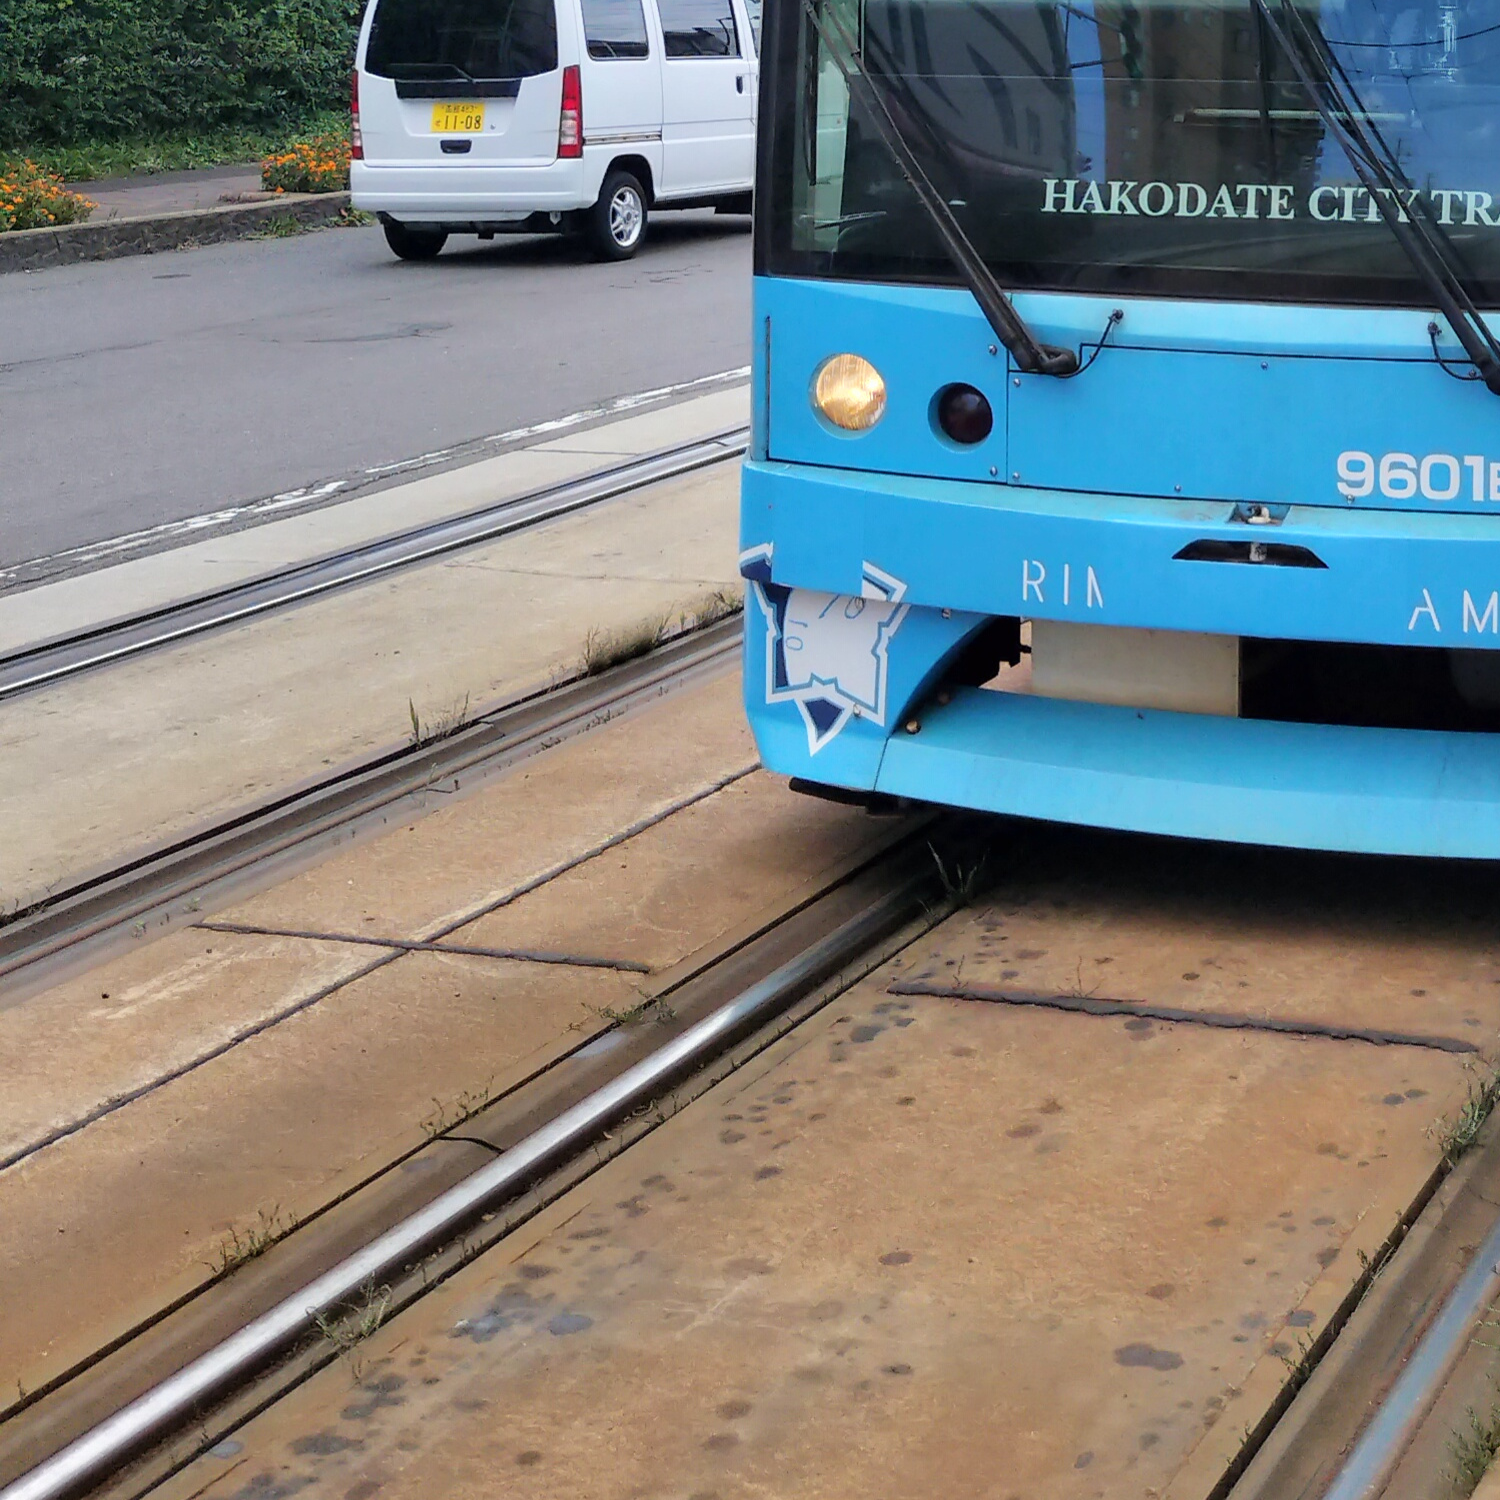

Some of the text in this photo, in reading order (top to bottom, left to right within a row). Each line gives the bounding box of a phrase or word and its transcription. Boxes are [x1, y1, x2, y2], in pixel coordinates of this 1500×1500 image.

[444, 115, 481, 130] 11-08
[1040, 178, 1295, 220] HAKODATE
[1308, 185, 1421, 224] CITY
